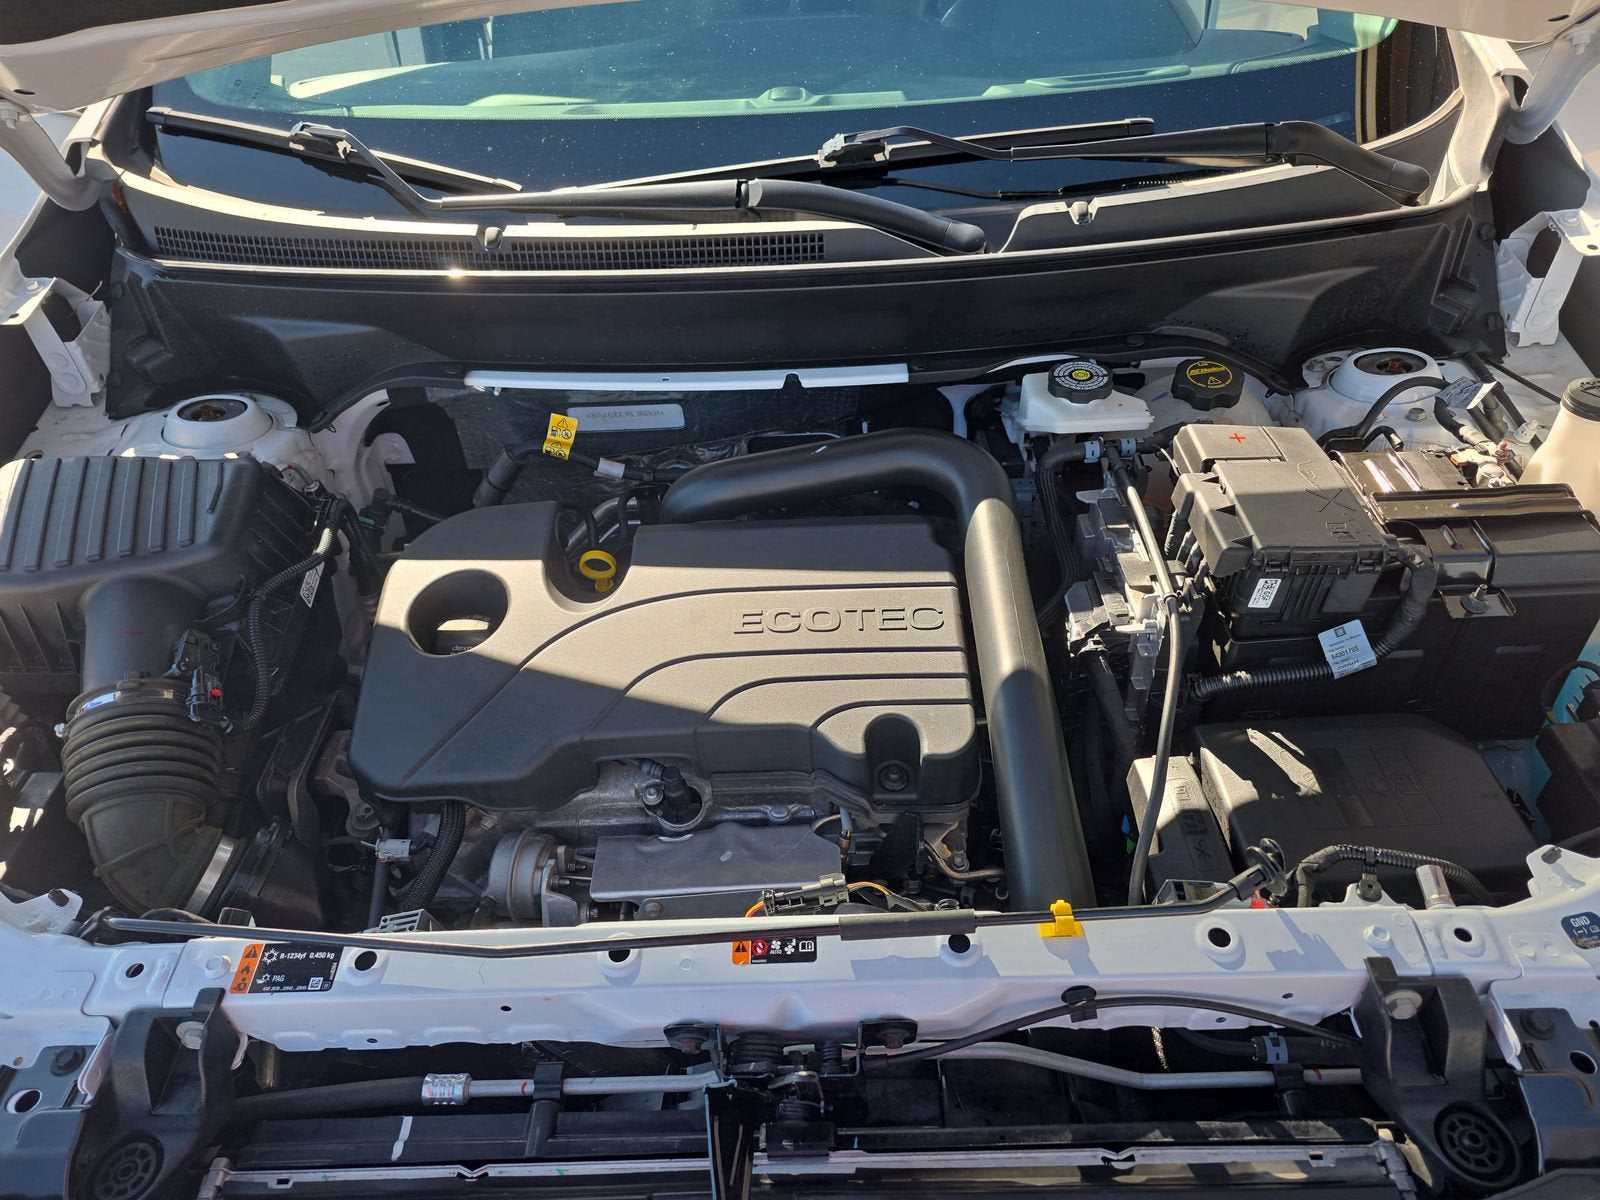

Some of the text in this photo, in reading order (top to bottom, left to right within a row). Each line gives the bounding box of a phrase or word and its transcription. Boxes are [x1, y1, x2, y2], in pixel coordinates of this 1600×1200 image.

[733, 606, 945, 634] ECOTEC
[1570, 915, 1590, 927] GND
[280, 952, 306, 961] R-1234yf
[326, 952, 335, 961] kg
[272, 974, 285, 982] PAG
